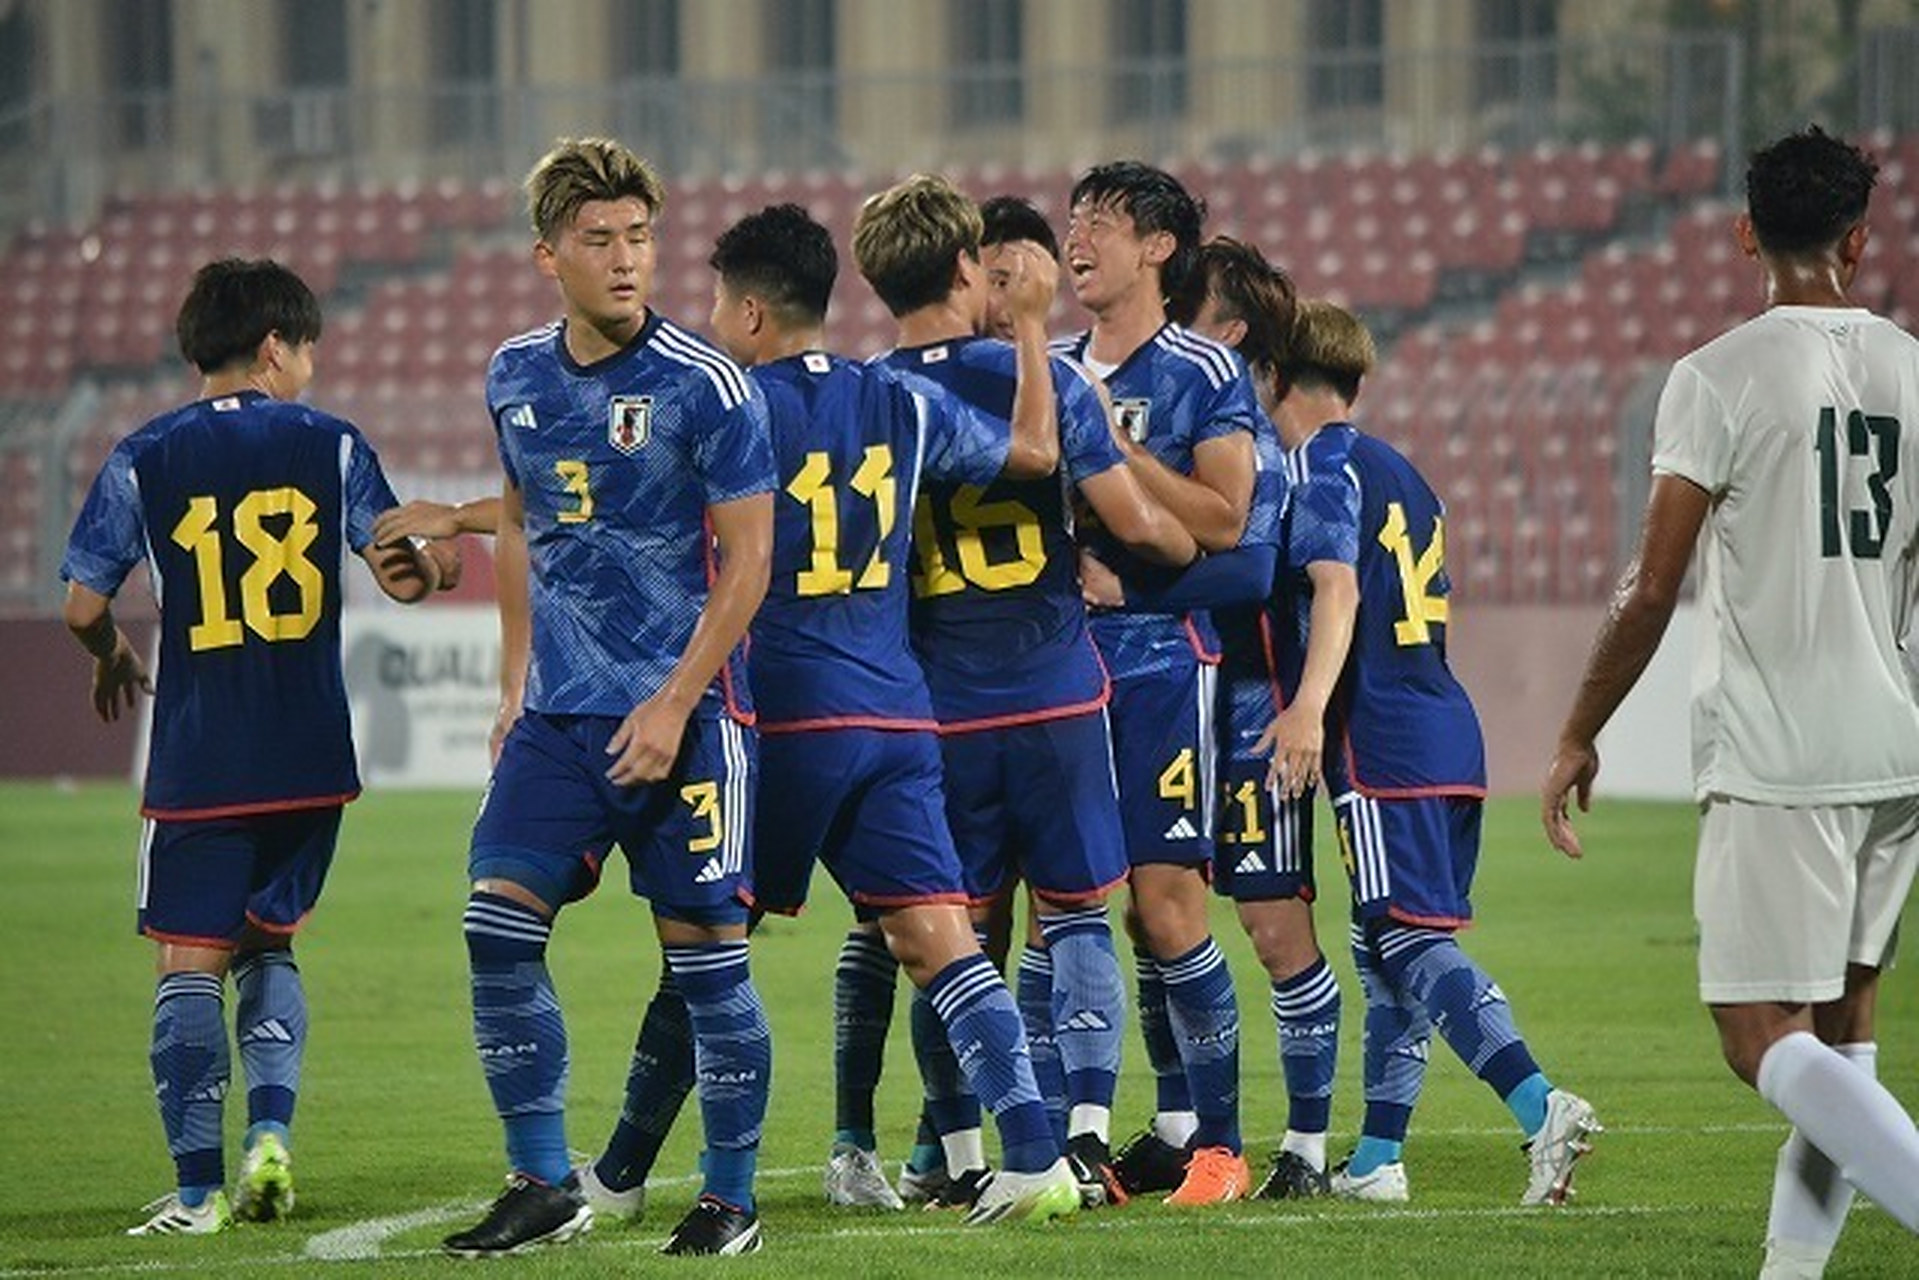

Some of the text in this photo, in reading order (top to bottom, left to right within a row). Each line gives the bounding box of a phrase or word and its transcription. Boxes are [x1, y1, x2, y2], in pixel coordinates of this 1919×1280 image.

[554, 459, 594, 524] 3
[1814, 405, 1900, 559] 13
[171, 486, 324, 652] 18
[1159, 748, 1195, 809] 4
[680, 781, 722, 852] 3
